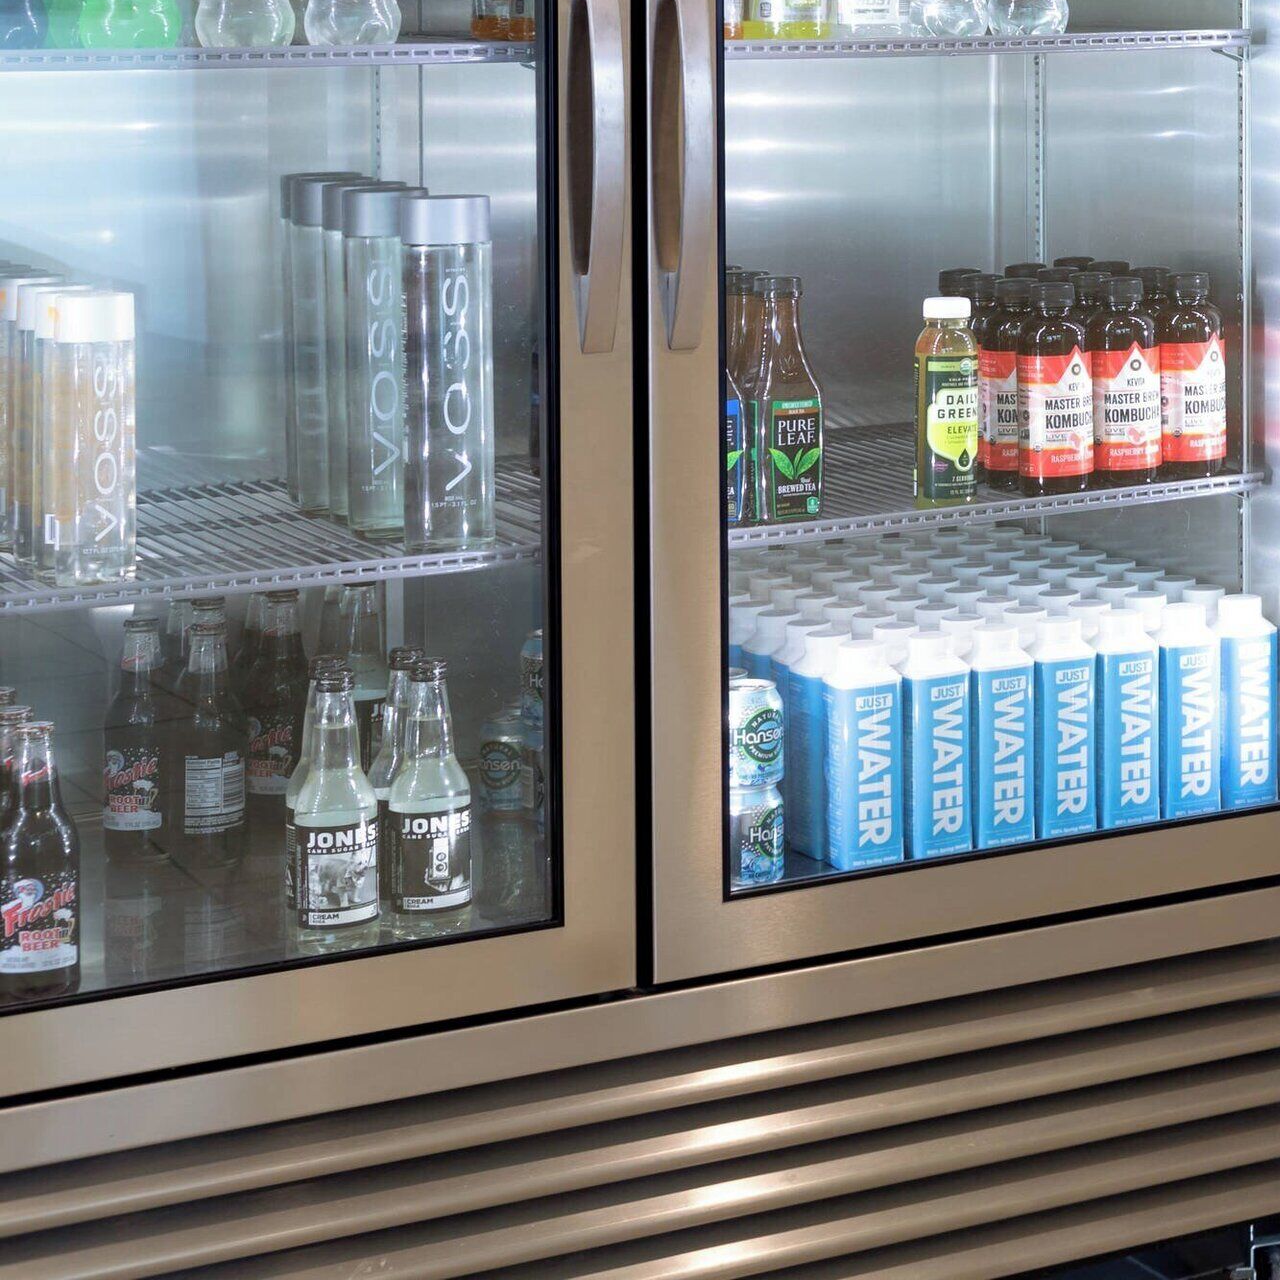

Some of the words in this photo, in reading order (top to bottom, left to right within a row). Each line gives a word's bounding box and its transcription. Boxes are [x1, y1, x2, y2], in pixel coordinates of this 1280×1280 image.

[368, 266, 401, 476] VOSS
[442, 274, 473, 491] VOSS
[1045, 399, 1080, 410] MASTER
[1104, 393, 1140, 405] MASTER
[778, 418, 816, 433] PURE
[778, 431, 816, 446] LEAF
[94, 365, 117, 542] VOSS
[777, 483, 804, 494] BREWED
[804, 483, 816, 491] TEA
[1059, 669, 1085, 682] JUST
[1121, 660, 1149, 674] JUST
[935, 686, 961, 699] JUST
[995, 678, 1022, 691] JUST
[859, 695, 889, 709] JUST
[1181, 669, 1212, 799] WATER
[1240, 660, 1270, 787] WATER
[1057, 682, 1089, 816] WATER
[1120, 672, 1151, 808] WATER
[932, 698, 964, 837] WATER
[994, 690, 1025, 827] WATER
[858, 707, 892, 848] WATER
[402, 810, 471, 834] JONES
[307, 822, 378, 848] JONES
[1, 881, 76, 938] Frostie
[19, 928, 61, 942] ROOT
[22, 940, 59, 953] BEER
